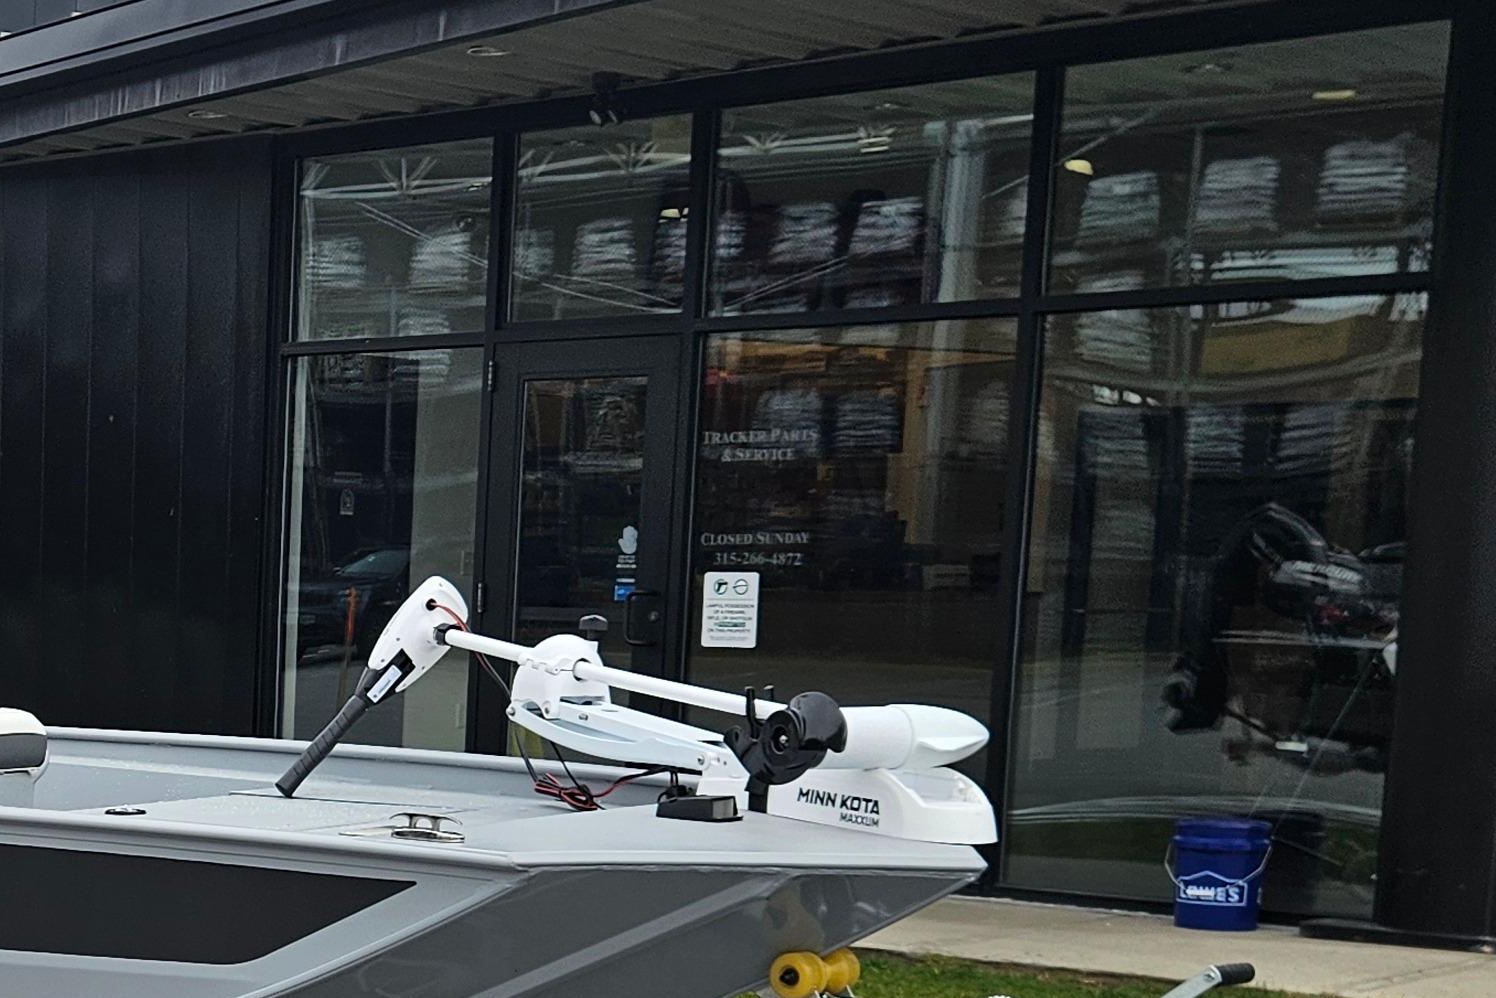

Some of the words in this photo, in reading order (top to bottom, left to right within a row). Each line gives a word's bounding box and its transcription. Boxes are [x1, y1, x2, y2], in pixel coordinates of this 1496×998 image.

[703, 430, 769, 444] TRACKER
[771, 428, 819, 443] PARTS
[720, 448, 732, 462] &
[734, 447, 796, 461] SERVICE
[701, 532, 753, 546] CLOSED
[756, 531, 810, 545] SUNDAY
[713, 552, 803, 566] 315-266-4872
[797, 788, 837, 808] MINN
[839, 794, 880, 815] KOTA
[839, 812, 880, 827] MAXXUM
